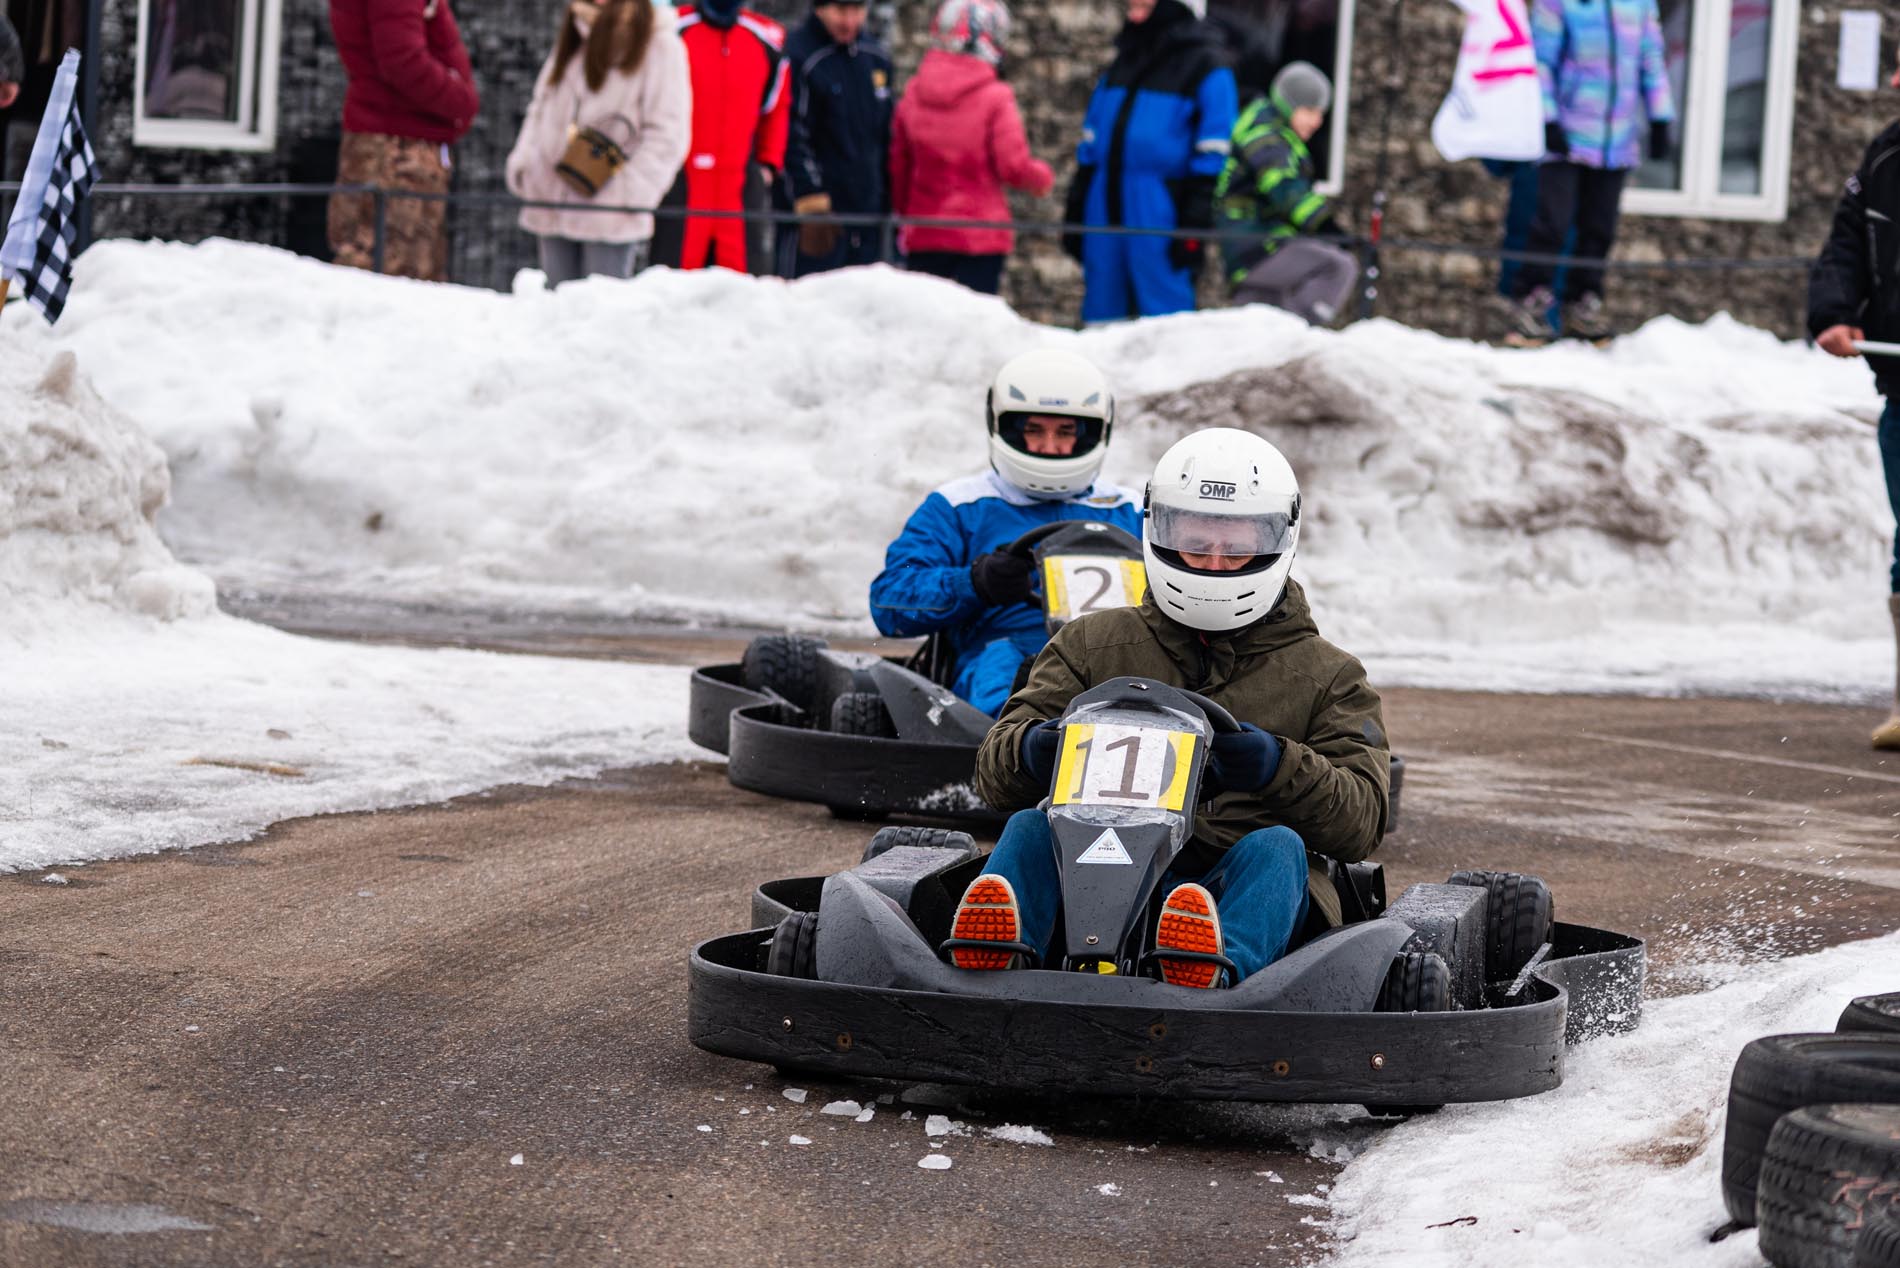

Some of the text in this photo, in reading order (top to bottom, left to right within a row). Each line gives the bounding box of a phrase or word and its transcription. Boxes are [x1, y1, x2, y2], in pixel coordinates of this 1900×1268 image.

[1199, 483, 1236, 498] OMP
[1073, 566, 1114, 614] 2
[1097, 735, 1150, 800] 1
